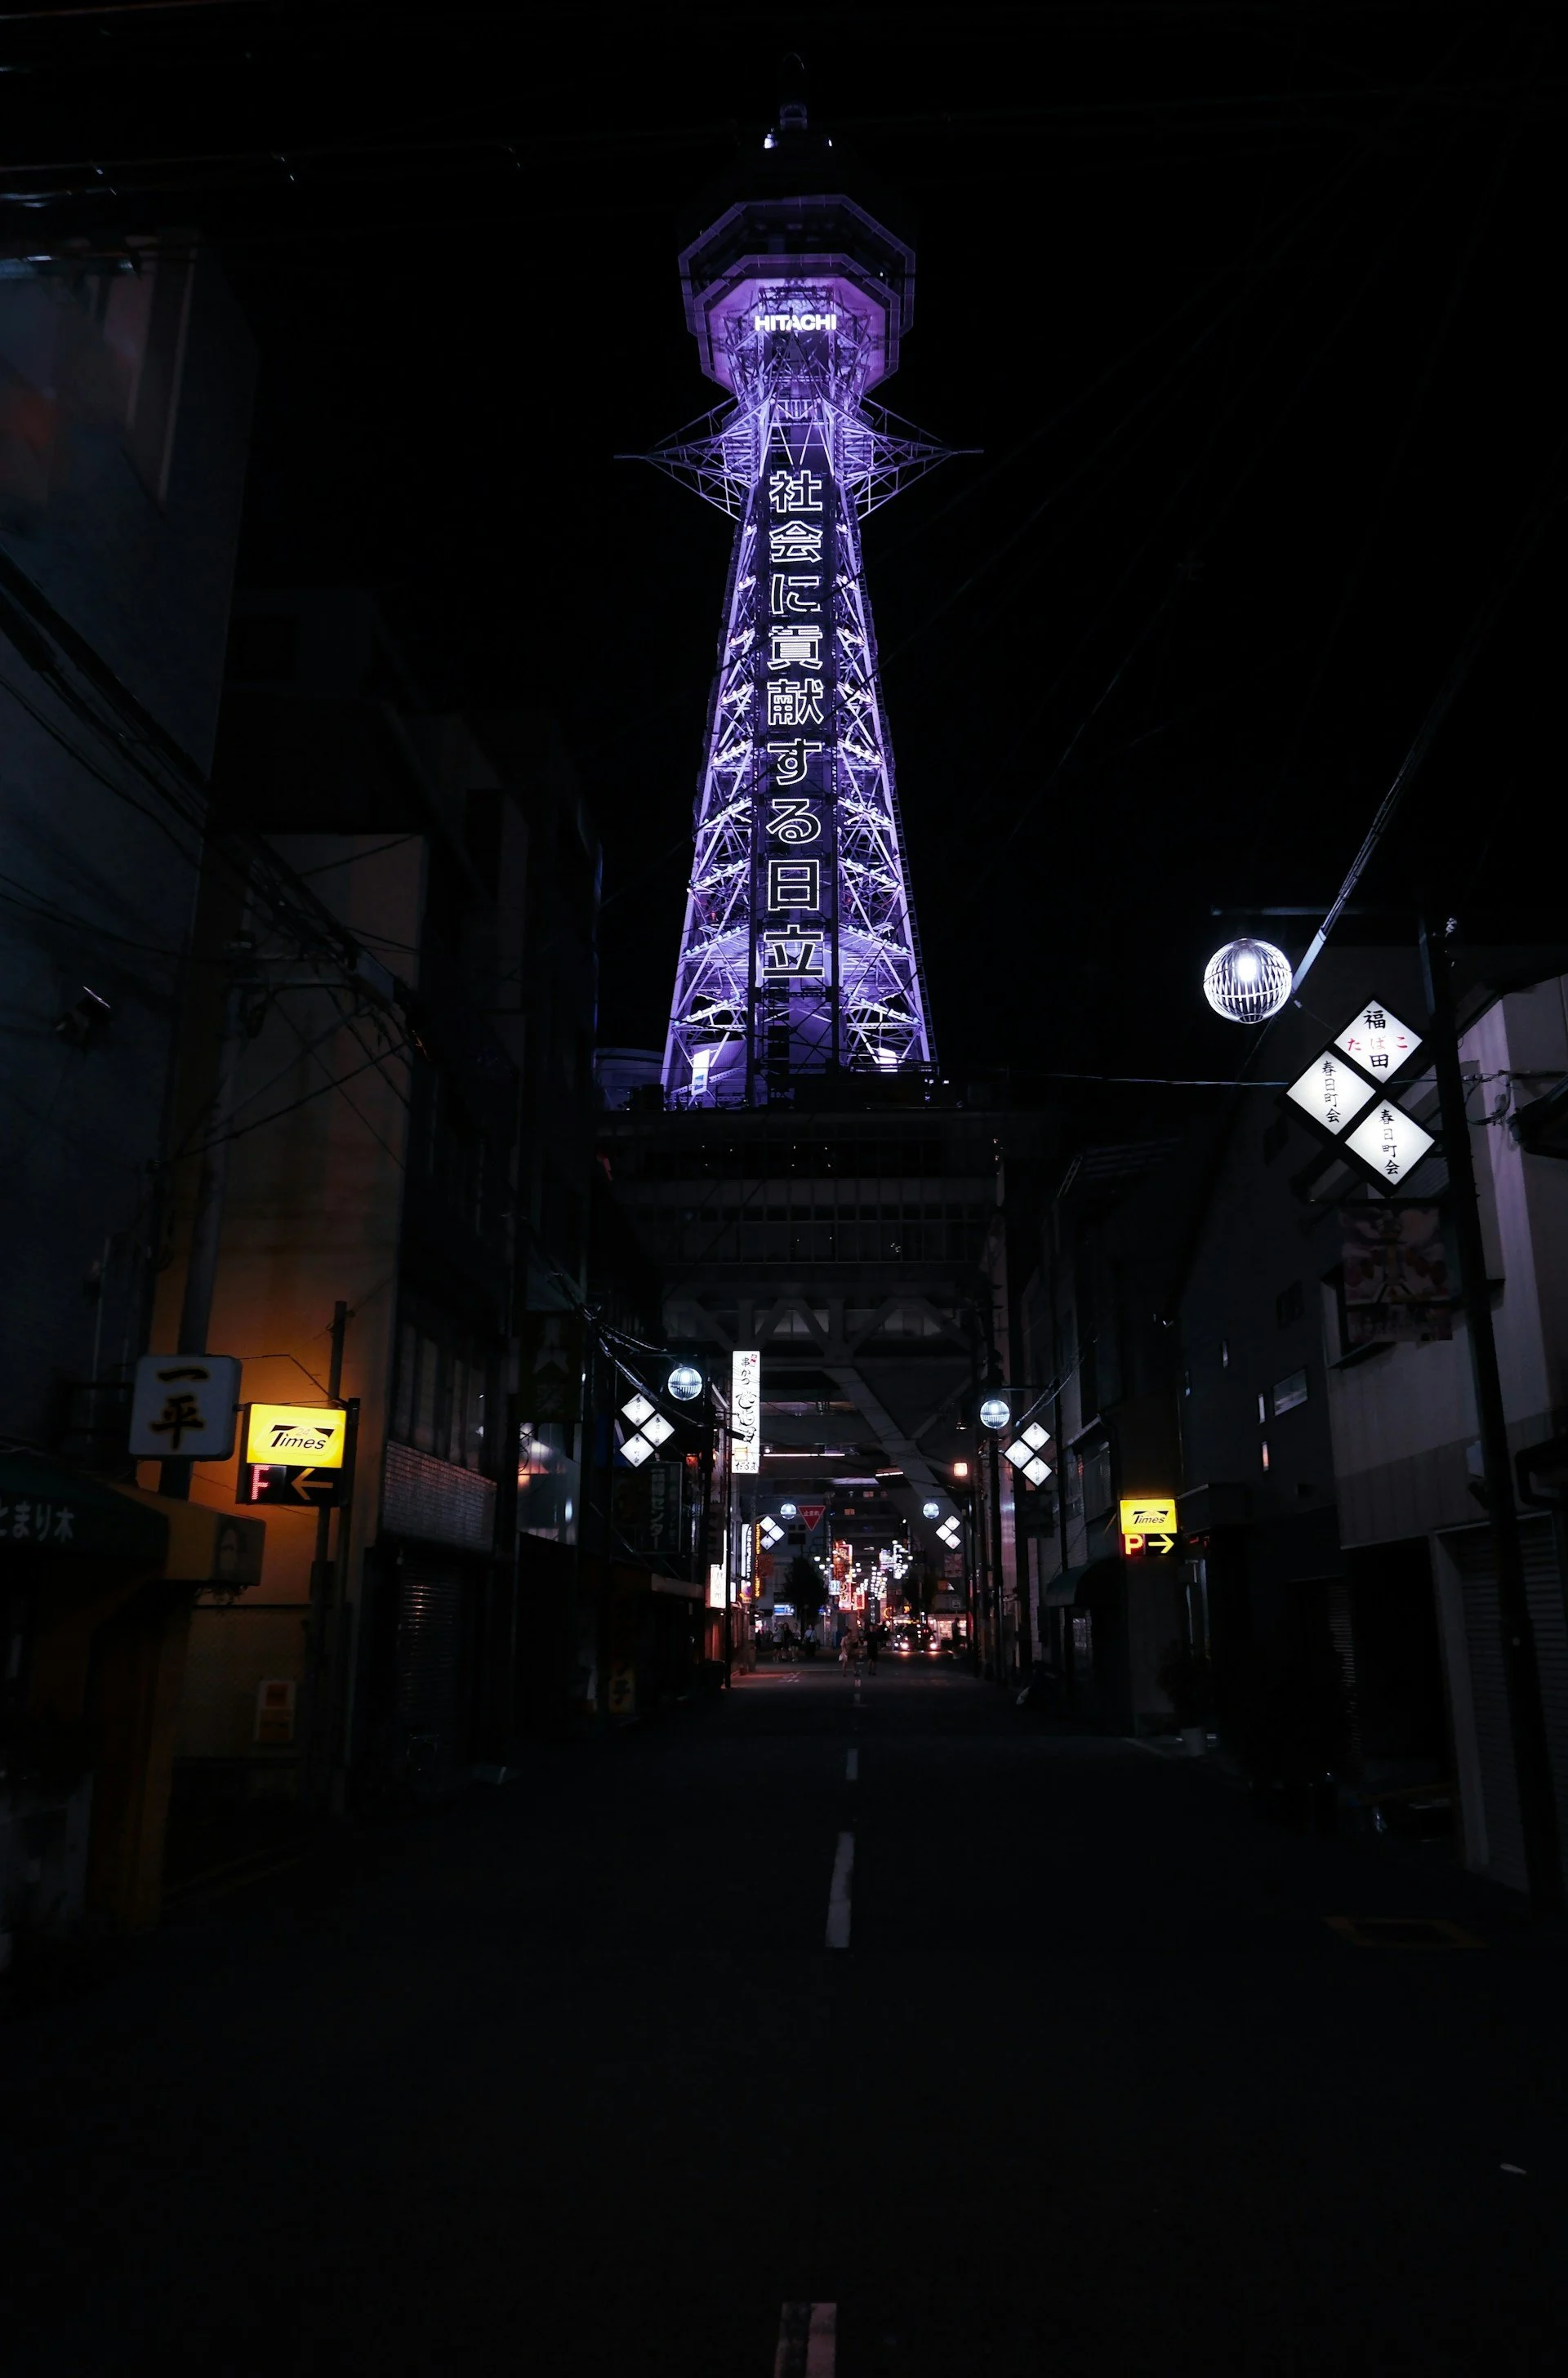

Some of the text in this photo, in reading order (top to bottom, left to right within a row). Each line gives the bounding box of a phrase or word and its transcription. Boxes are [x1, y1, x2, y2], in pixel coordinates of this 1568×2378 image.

[755, 314, 836, 331] HITACHI
[761, 470, 825, 978] 社会に貢献する日立
[1348, 1035, 1408, 1052] たばこ
[1364, 1010, 1389, 1069] 福田
[1322, 1060, 1341, 1124] 春日町会
[1379, 1109, 1400, 1175] 春日町会
[152, 1369, 207, 1449] 一平
[270, 1425, 334, 1449] Times
[1133, 1511, 1169, 1524] Times
[1125, 1534, 1143, 1555] P
